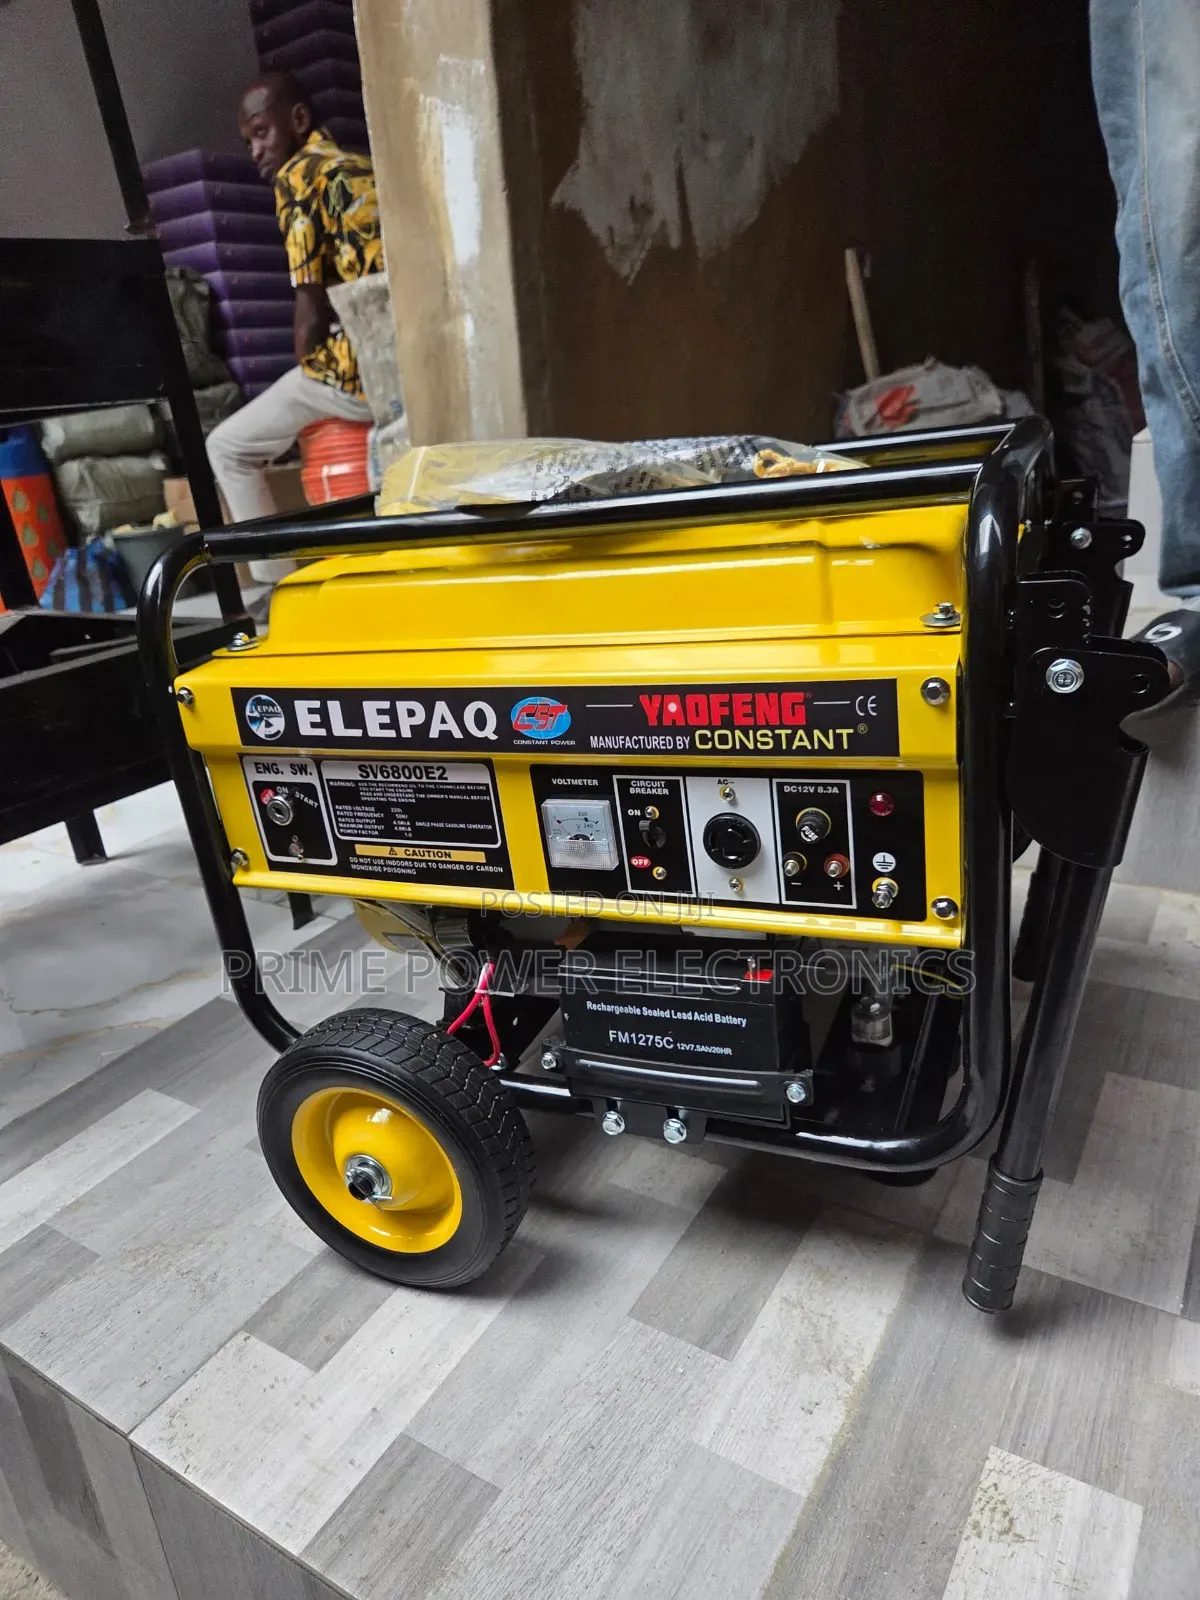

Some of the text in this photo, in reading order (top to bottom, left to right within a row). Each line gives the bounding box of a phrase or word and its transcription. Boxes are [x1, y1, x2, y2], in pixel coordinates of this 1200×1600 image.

[639, 692, 806, 726] YAOFENG
[856, 696, 877, 716] CE
[294, 700, 499, 740] ELEPAQ
[512, 703, 568, 731] CST
[590, 729, 854, 750] MANUFACTURED BY CONSTANT
[254, 762, 312, 776] ENG. SW.
[358, 764, 448, 780] SV6800E2
[294, 791, 318, 808] START
[802, 826, 818, 841] FUSE
[404, 849, 452, 858] CAUTION
[351, 864, 382, 872] MONOXIDE
[586, 1001, 747, 1027] Rechargeable Sealed Lead Acid Battery
[608, 1030, 674, 1049] FM1275C
